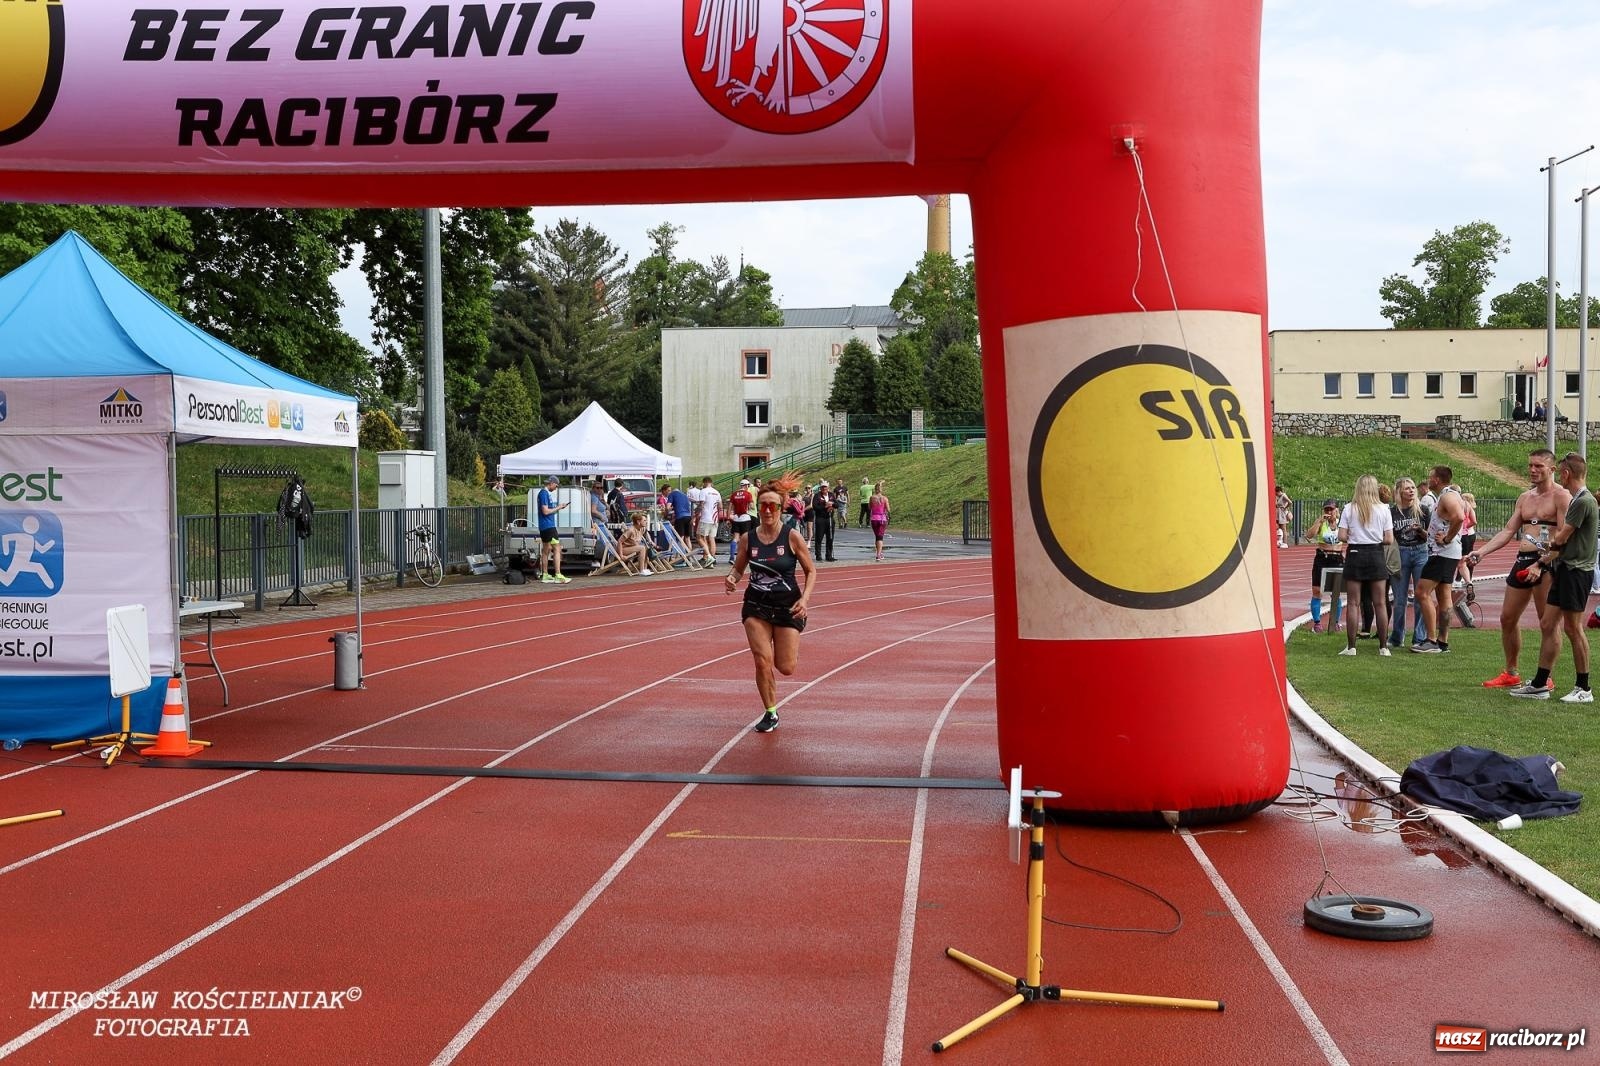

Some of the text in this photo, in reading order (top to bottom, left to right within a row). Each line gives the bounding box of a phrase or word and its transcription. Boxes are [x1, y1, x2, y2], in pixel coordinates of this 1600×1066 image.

[122, 0, 598, 62] BEZ GRANIC
[174, 79, 559, 147] RACIBÓRZ
[99, 403, 143, 418] MITKO
[188, 392, 265, 425] PersonalBest
[1139, 387, 1252, 441] SIR
[0, 602, 48, 614] RENINGI
[0, 618, 49, 630] IEGOWE
[0, 635, 53, 663] st.pl
